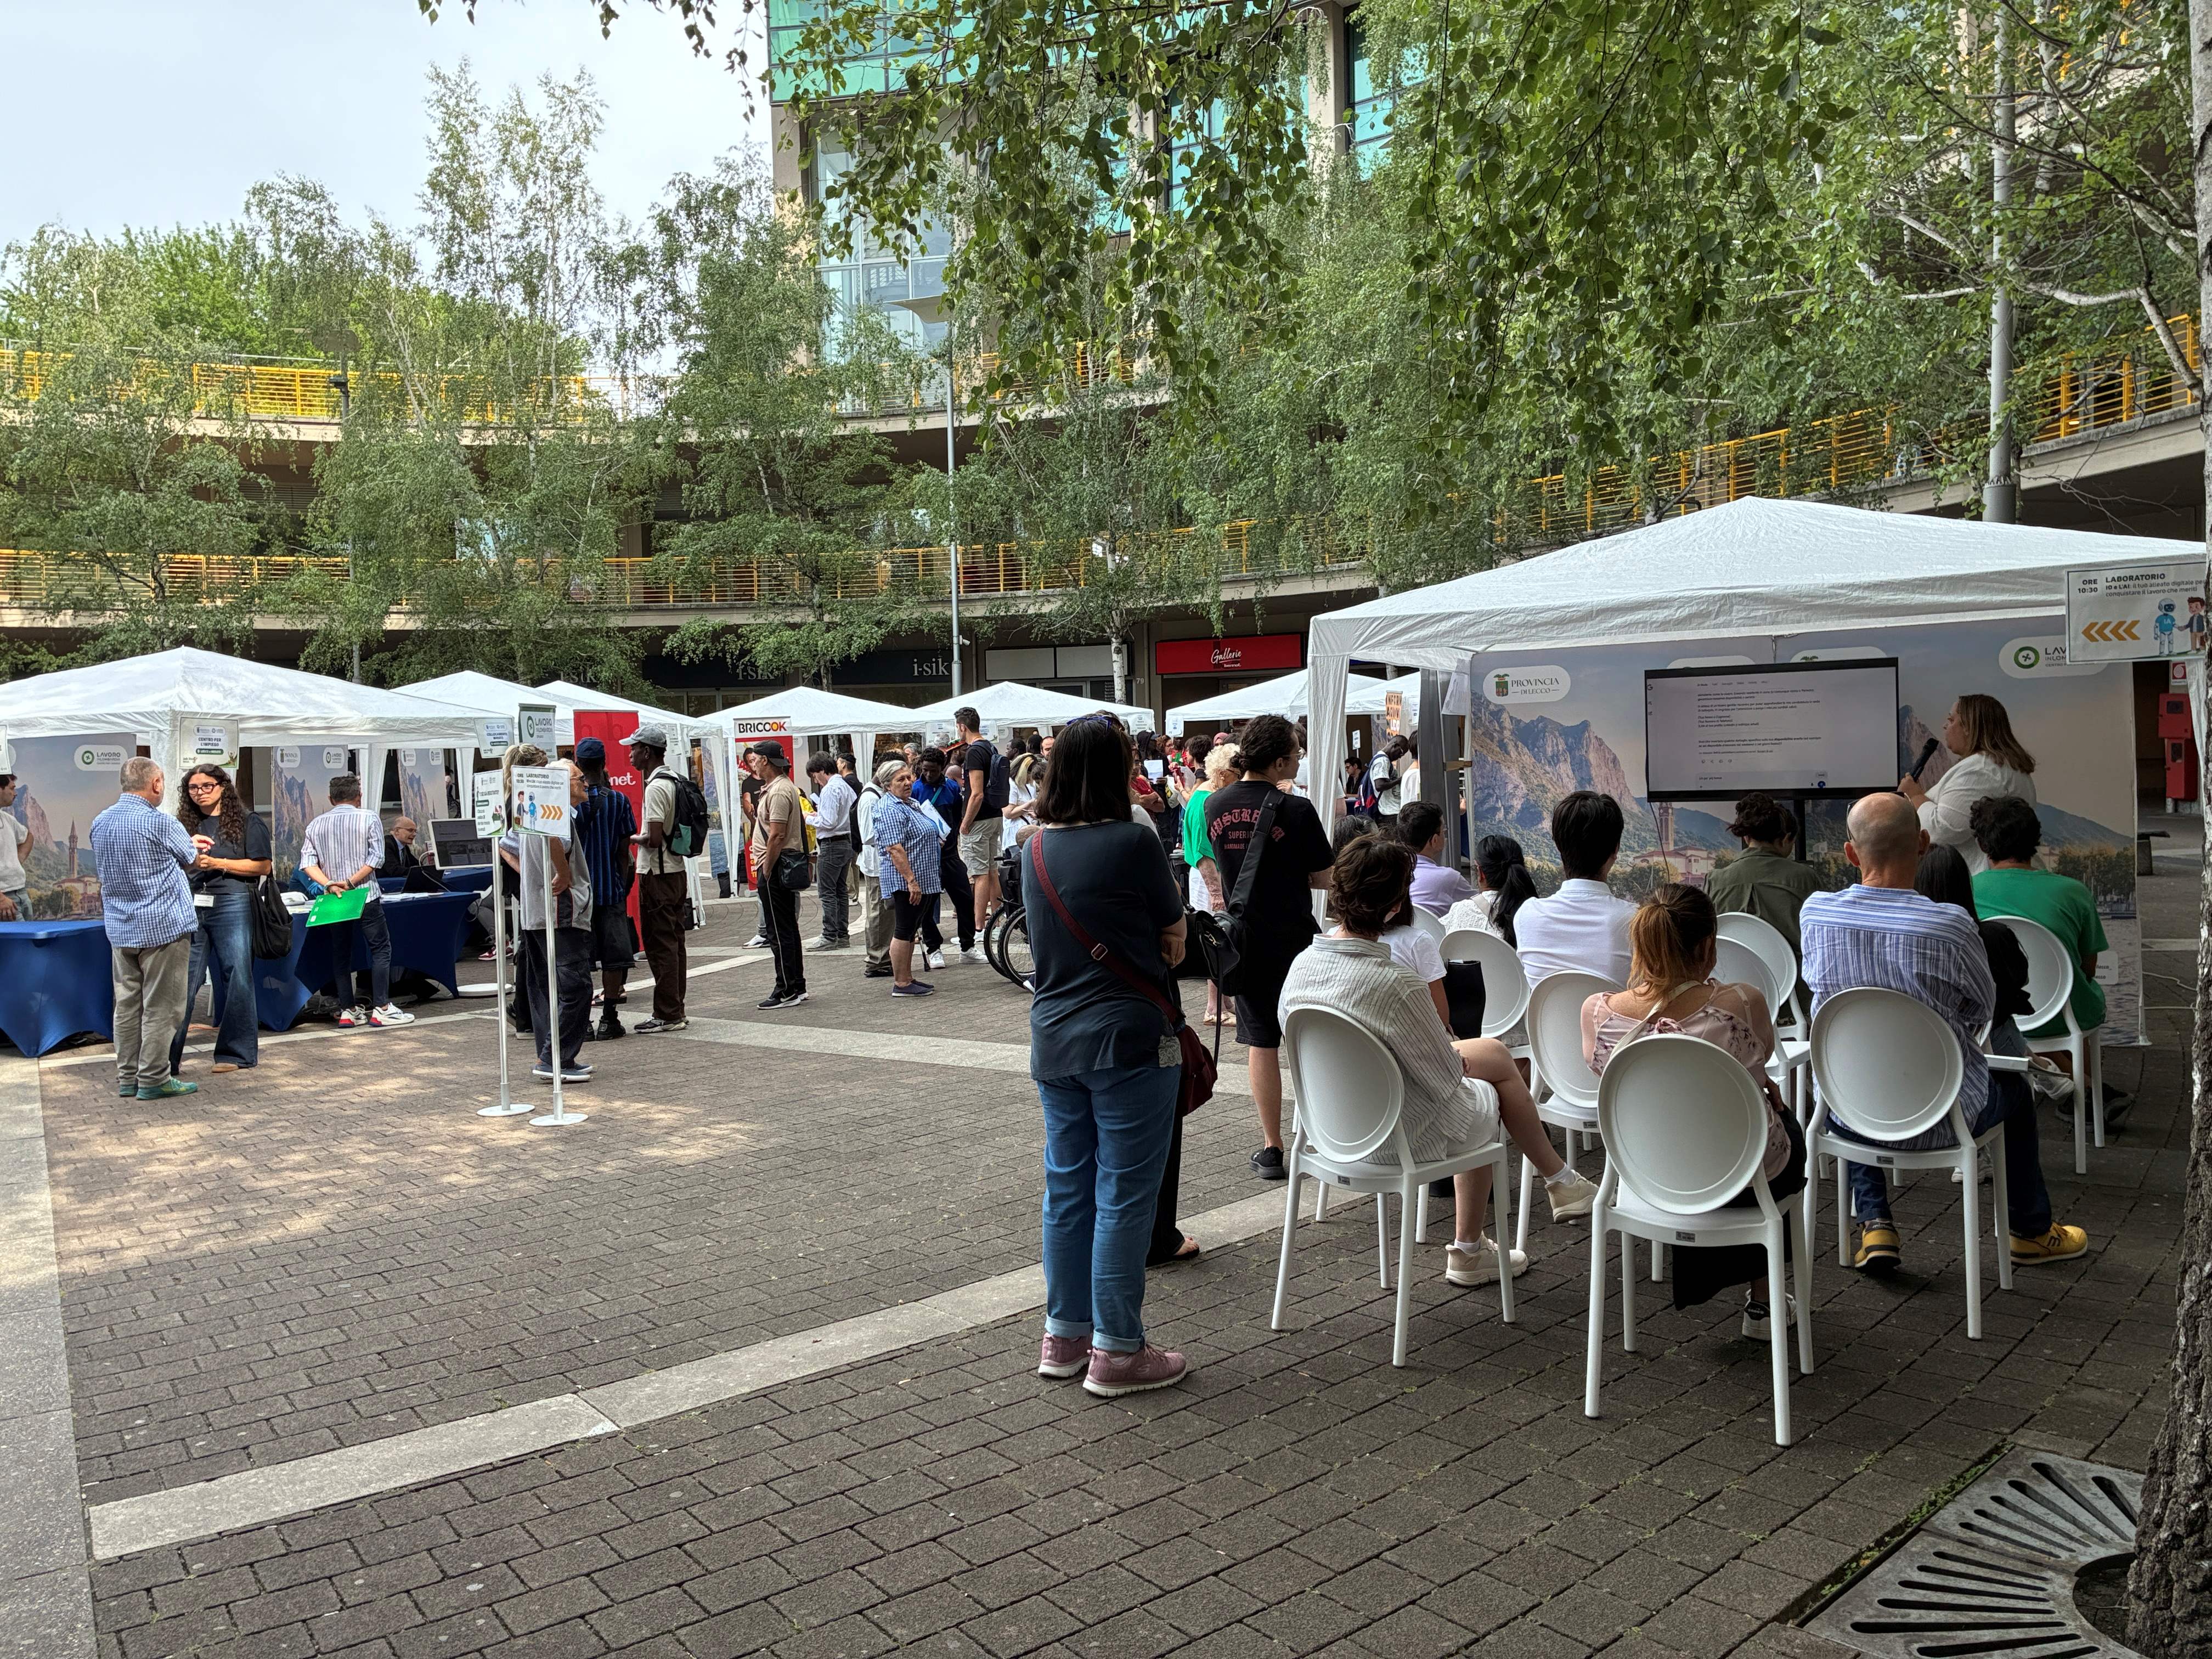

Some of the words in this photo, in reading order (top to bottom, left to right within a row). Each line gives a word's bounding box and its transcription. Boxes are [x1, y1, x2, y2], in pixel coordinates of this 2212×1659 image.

[2106, 573, 2166, 583] LABORATORIO
[1211, 647, 1242, 664] Gallerie
[913, 658, 950, 676] i-sik
[1511, 678, 1560, 687] PROVINCIA
[738, 721, 787, 733] BRICOOK
[609, 772, 636, 786] net
[1228, 830, 1255, 839] SUPERIO
